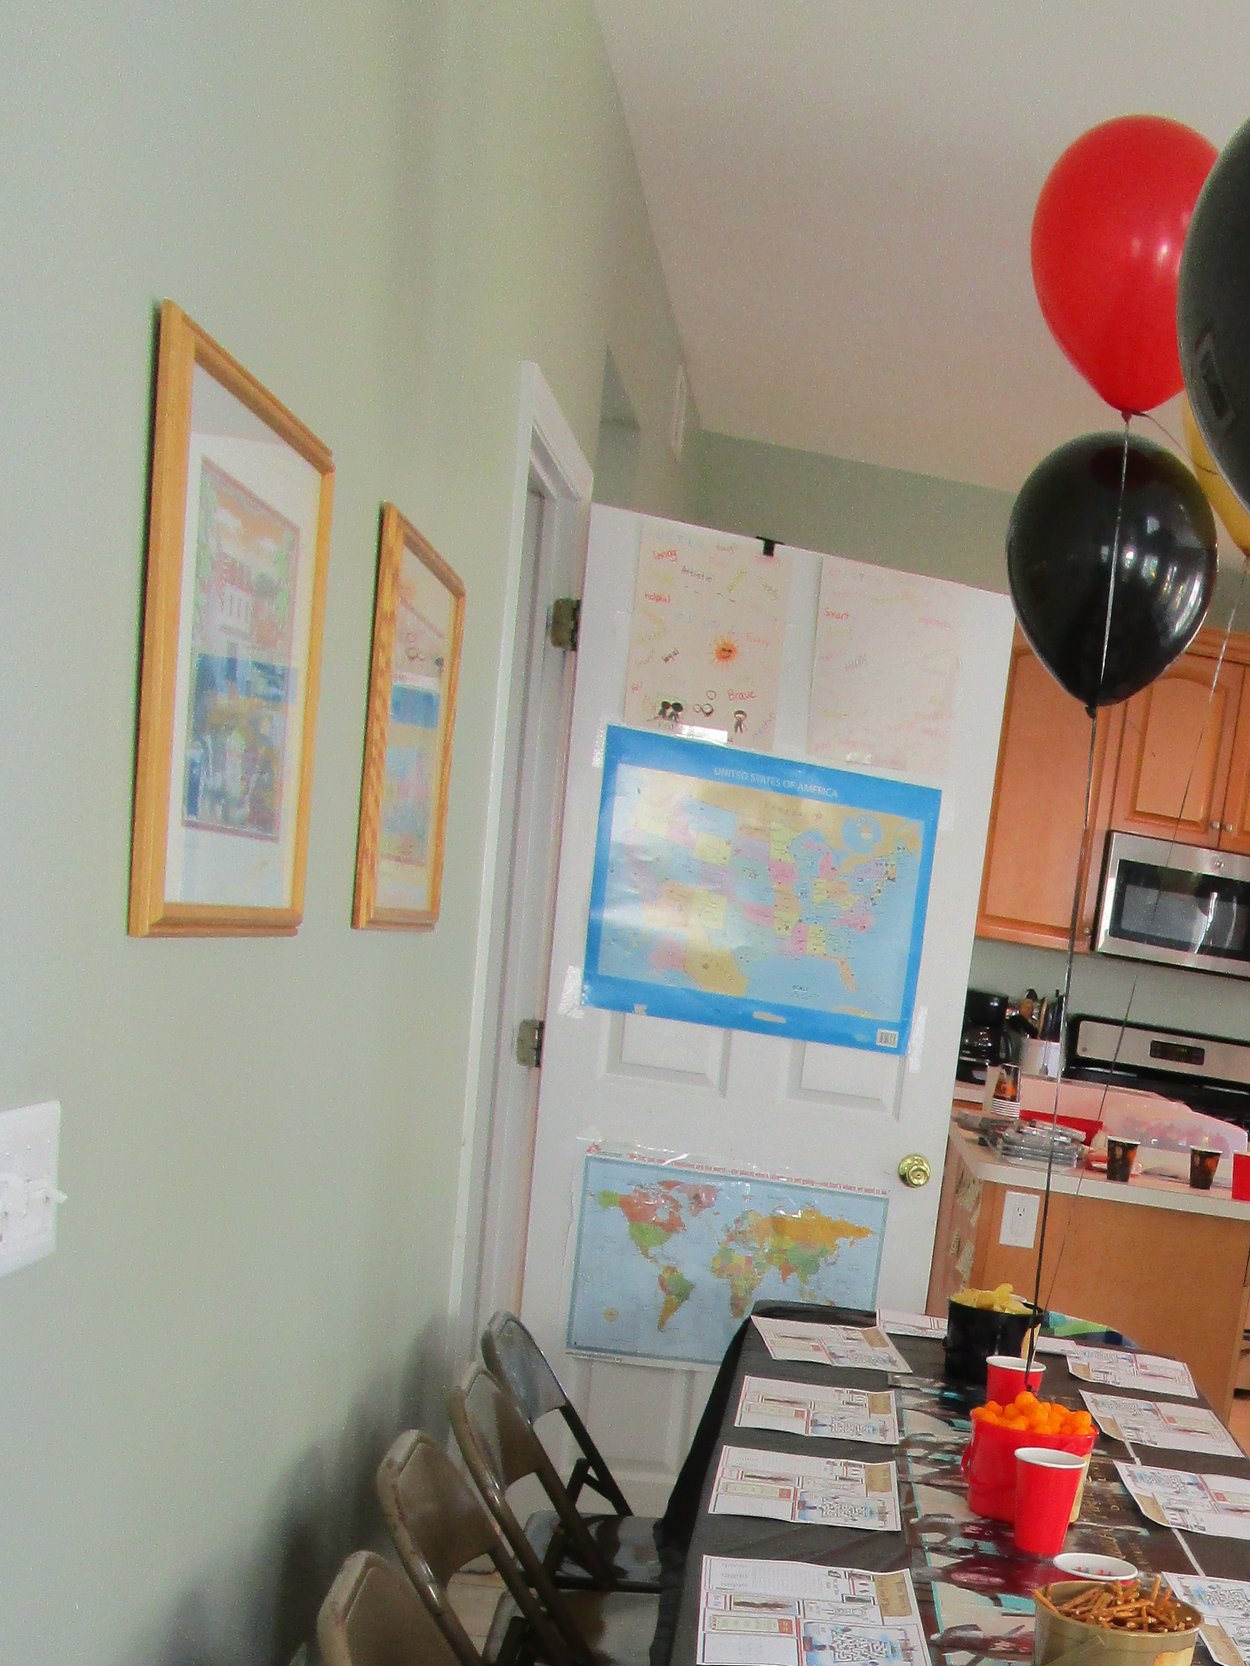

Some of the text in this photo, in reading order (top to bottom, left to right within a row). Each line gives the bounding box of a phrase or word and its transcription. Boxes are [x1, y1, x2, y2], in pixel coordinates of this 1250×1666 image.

[713, 767, 839, 798] UNITED STATES OF AMERICA
